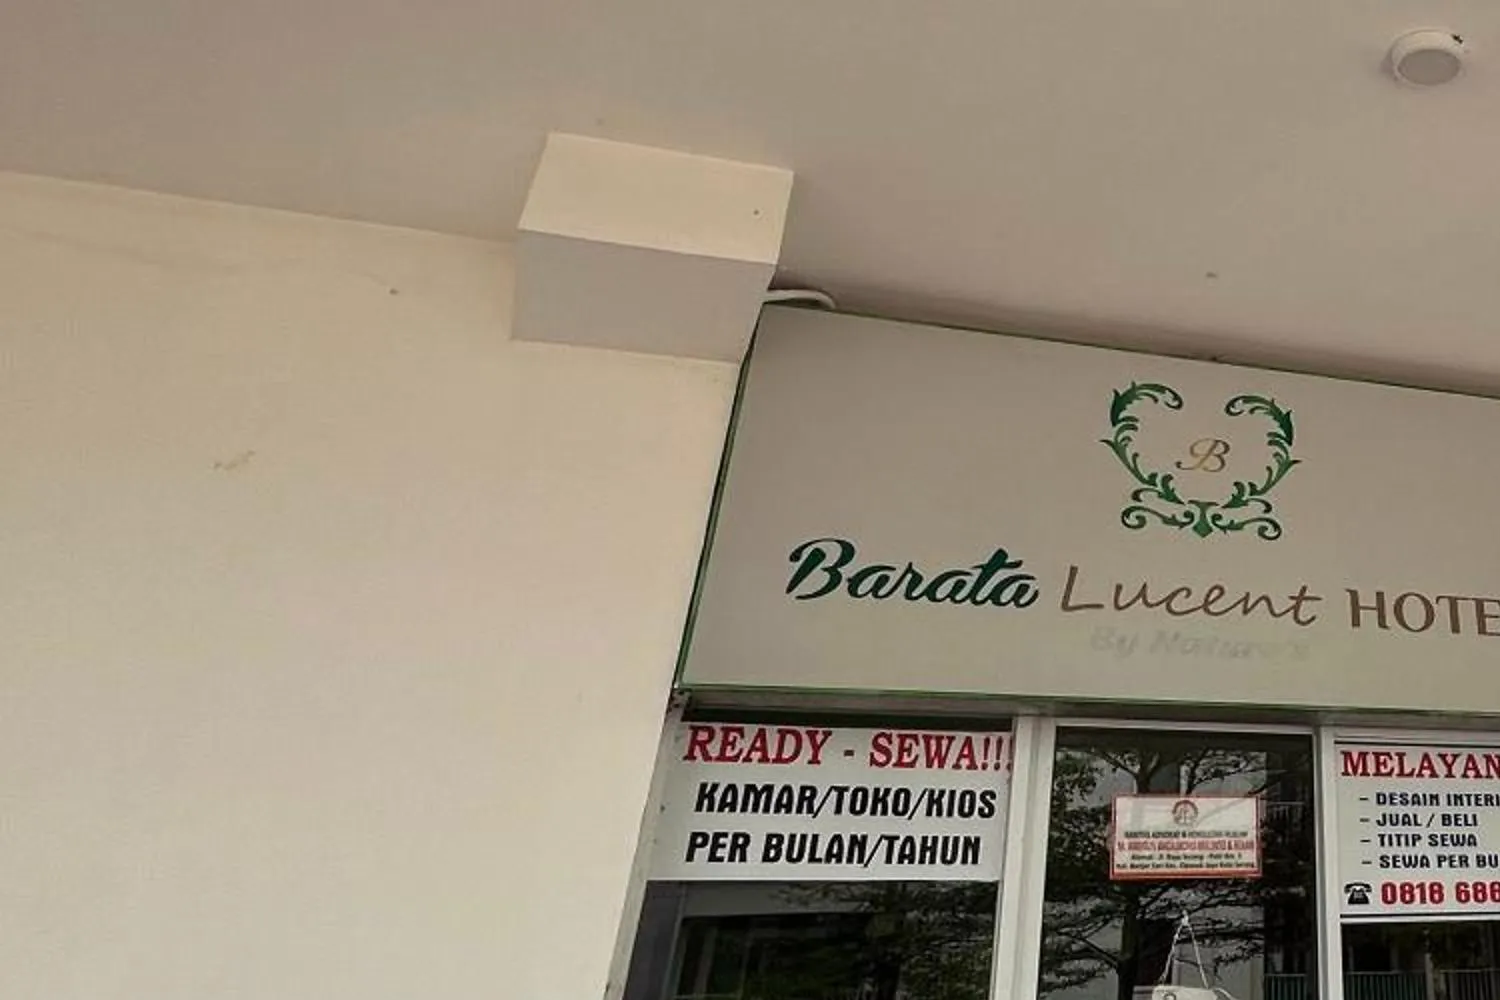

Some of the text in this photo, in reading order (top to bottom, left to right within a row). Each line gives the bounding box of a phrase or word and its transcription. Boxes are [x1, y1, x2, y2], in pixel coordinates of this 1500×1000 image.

[786, 539, 1038, 608] Barata
[1060, 564, 1325, 627] Lucent
[682, 724, 832, 765] READY
[695, 782, 996, 820] KAMAR/TOKO/KIOS
[1376, 793, 1439, 806] DESAIN
[1376, 813, 1422, 826] JUAL
[1441, 814, 1477, 826] BELI
[686, 832, 980, 867] PER BULAN/TAHUN
[1378, 834, 1422, 847] TITIP
[1428, 834, 1477, 847] SEWA
[1380, 855, 1430, 868] SEWA
[1437, 855, 1469, 868] PER
[1382, 882, 1444, 904] 0818
